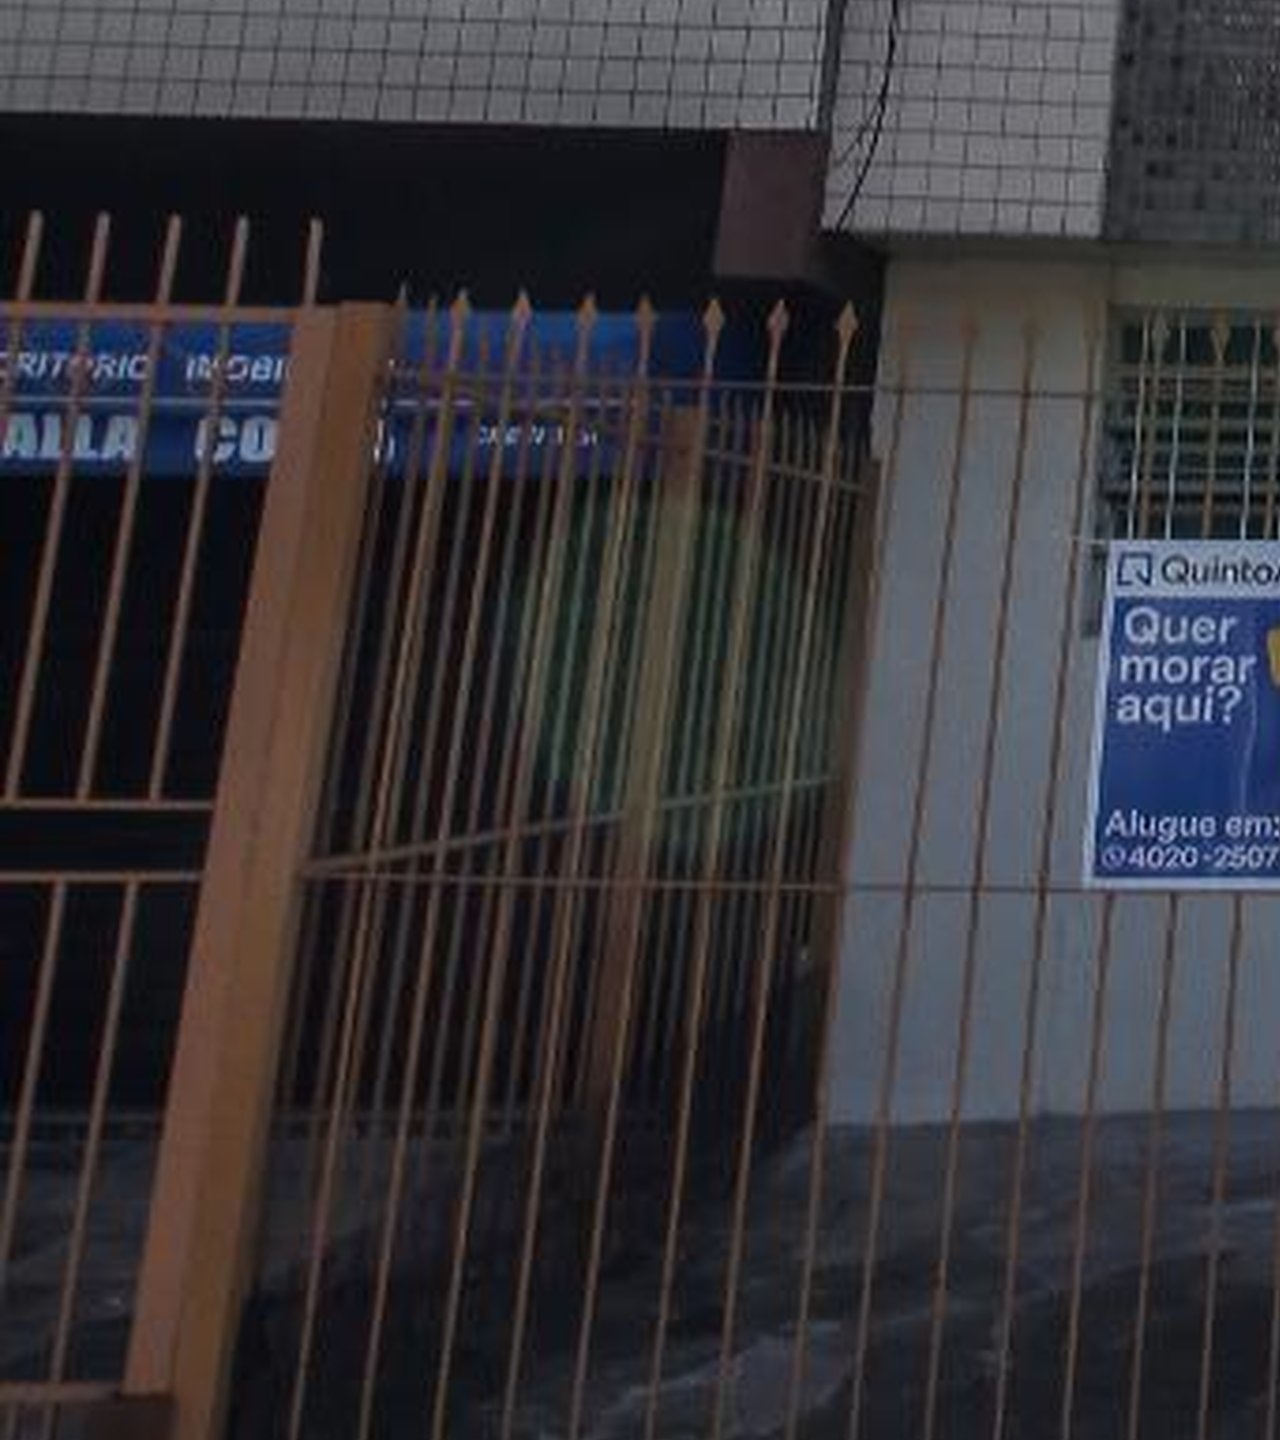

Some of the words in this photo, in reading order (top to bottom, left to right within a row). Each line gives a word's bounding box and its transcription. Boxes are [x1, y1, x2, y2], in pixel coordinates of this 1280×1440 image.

[1123, 606, 1238, 645] Quer
[1119, 653, 1258, 685] morar
[1116, 685, 1243, 733] aqui?
[1104, 808, 1217, 844] Alugue
[1224, 815, 1280, 838] em:
